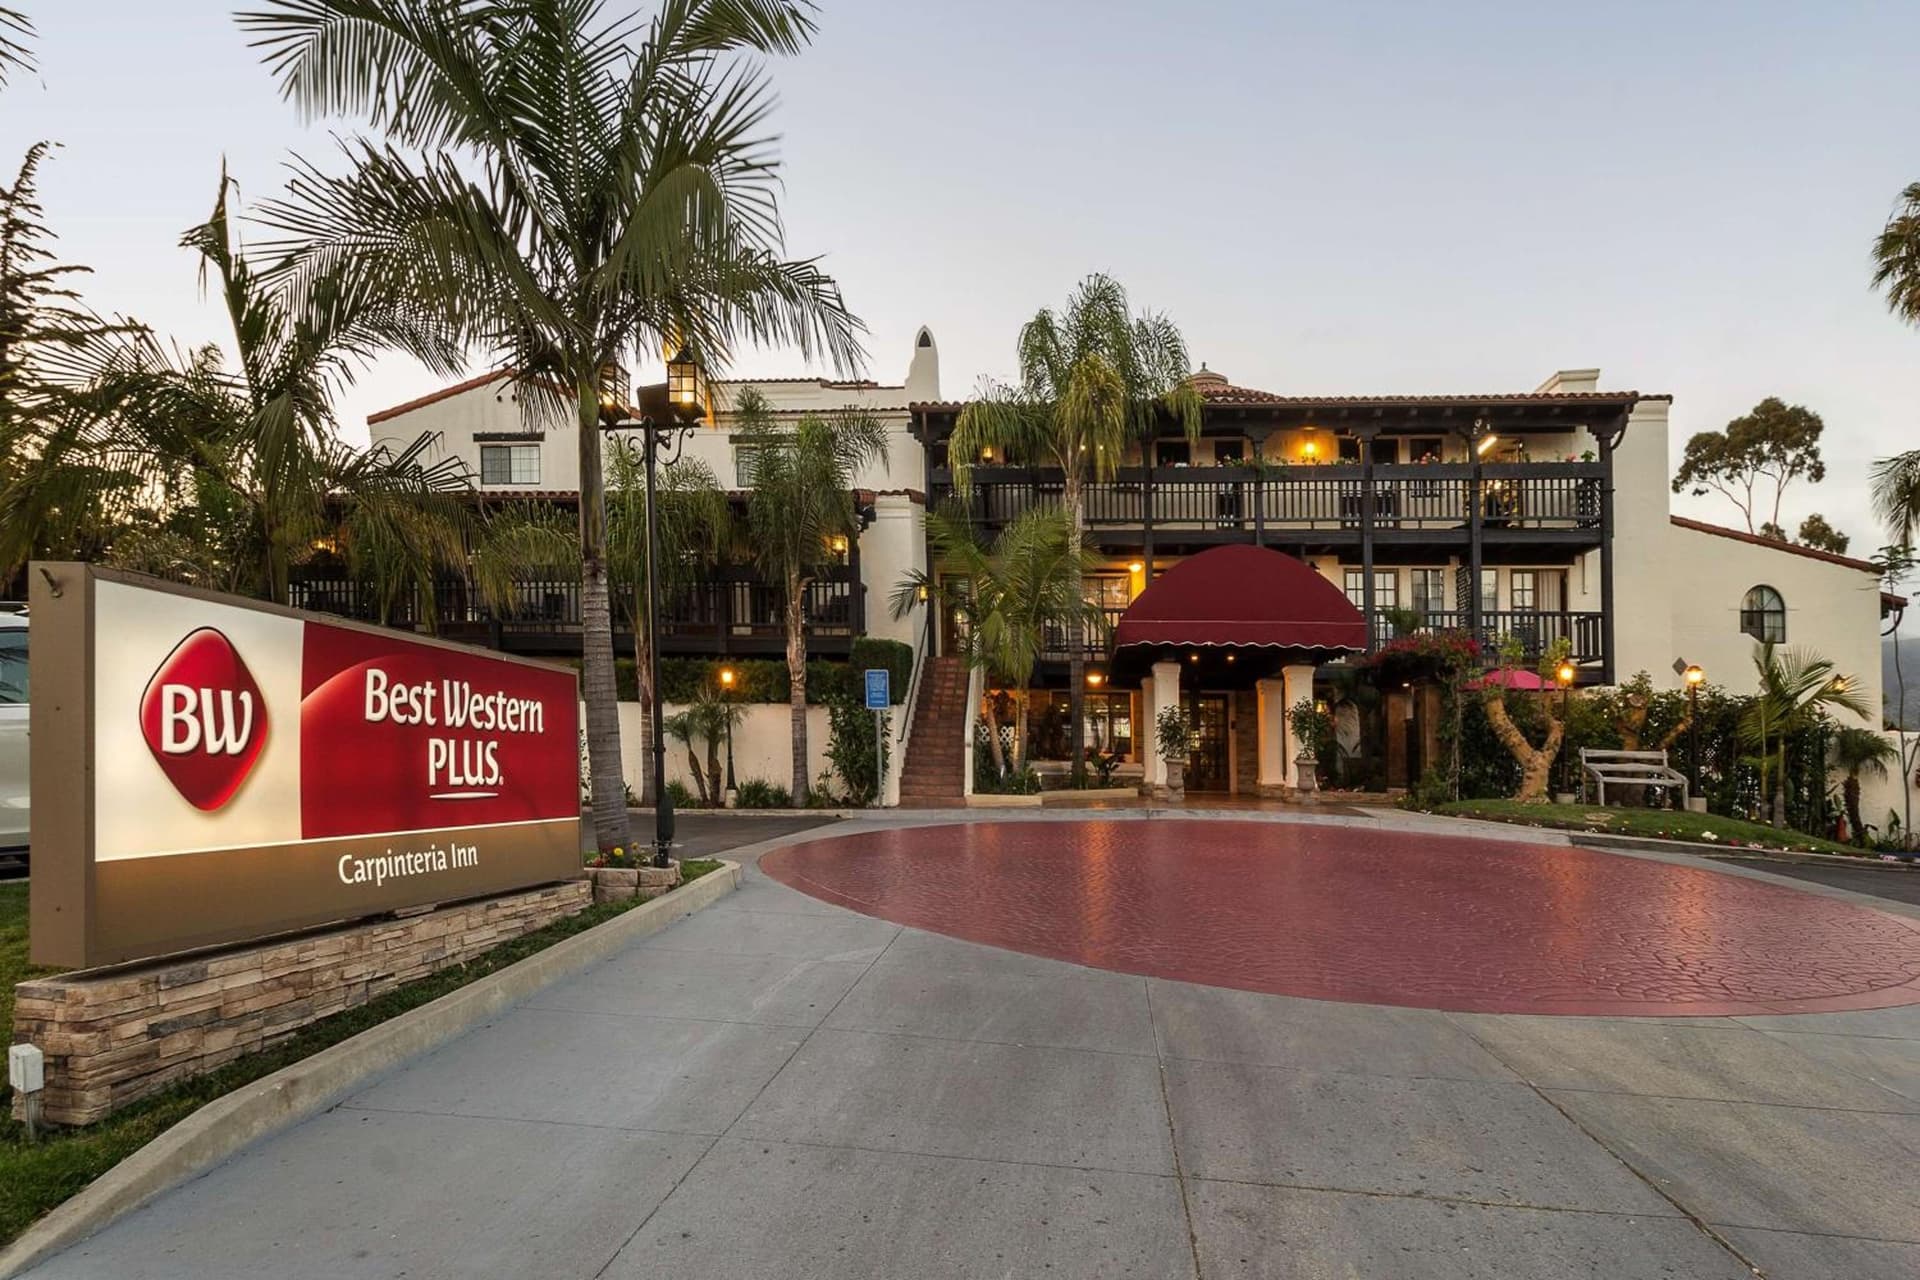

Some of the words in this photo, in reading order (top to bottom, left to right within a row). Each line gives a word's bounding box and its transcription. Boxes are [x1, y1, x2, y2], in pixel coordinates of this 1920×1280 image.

[161, 684, 254, 756] BW
[364, 668, 438, 726] Best
[443, 679, 545, 734] Western
[338, 843, 447, 886] Carpinteria
[451, 843, 479, 869] Inn
